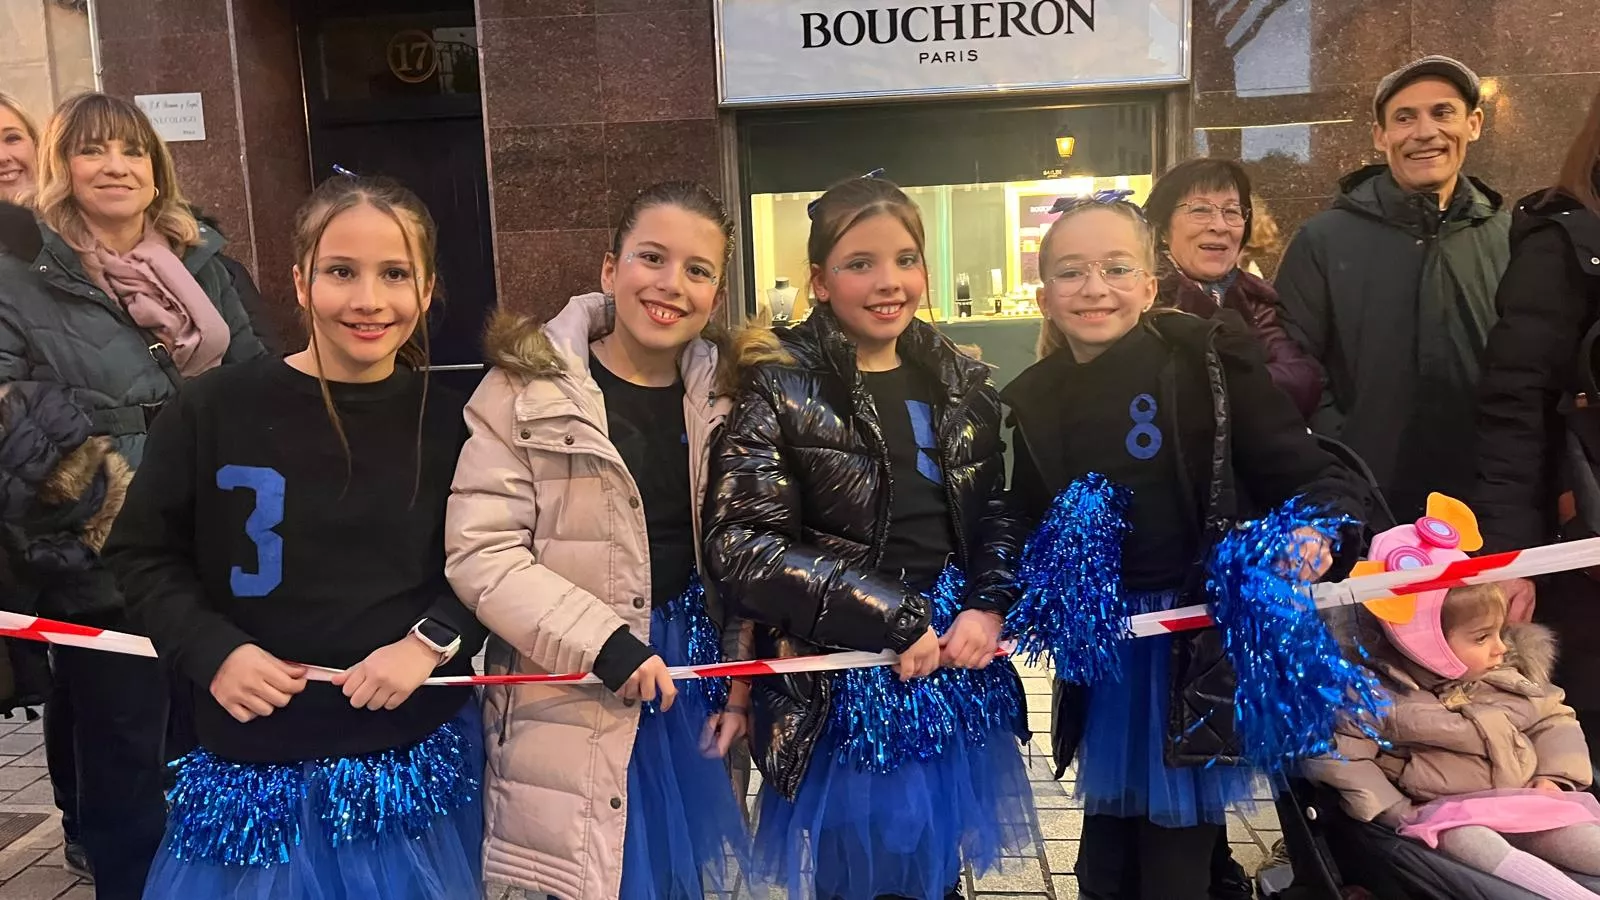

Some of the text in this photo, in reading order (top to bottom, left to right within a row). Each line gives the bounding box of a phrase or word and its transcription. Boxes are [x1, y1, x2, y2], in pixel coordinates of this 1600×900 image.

[800, 0, 1095, 48] BOUCHERON
[394, 41, 429, 72] 17
[919, 49, 978, 64] PARIS
[1125, 393, 1163, 460] 8
[216, 464, 286, 597] 3
